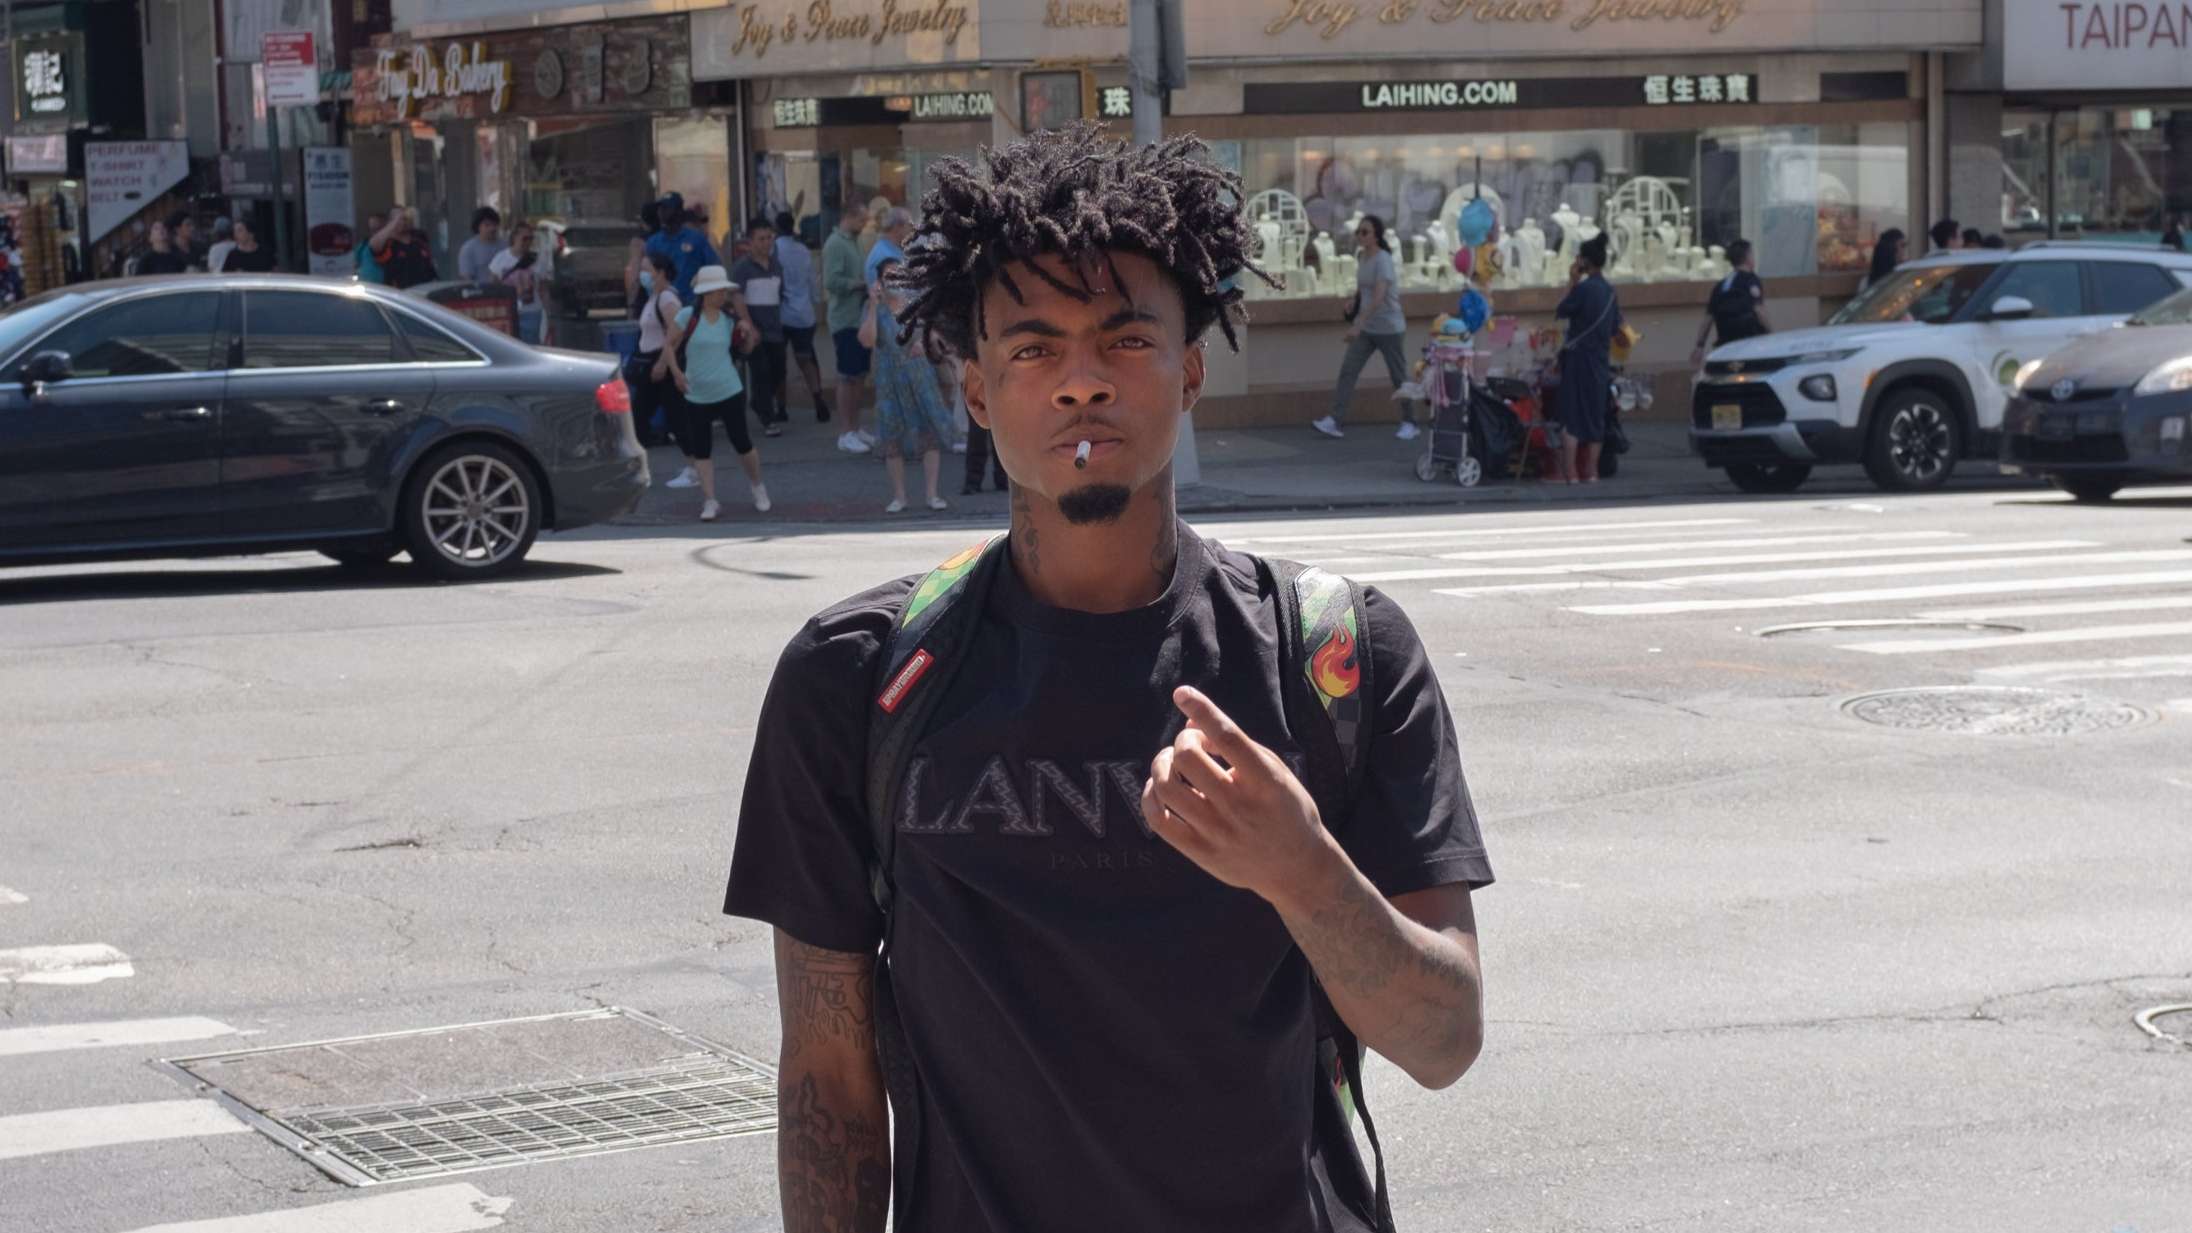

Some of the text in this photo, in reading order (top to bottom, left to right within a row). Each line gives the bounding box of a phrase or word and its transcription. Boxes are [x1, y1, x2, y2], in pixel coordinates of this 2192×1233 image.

[731, 4, 772, 58] Joy
[781, 12, 797, 44] &
[443, 40, 508, 114] Bakery
[1362, 80, 1517, 107] LAIHING.COM
[1049, 851, 1154, 869] PARIS
